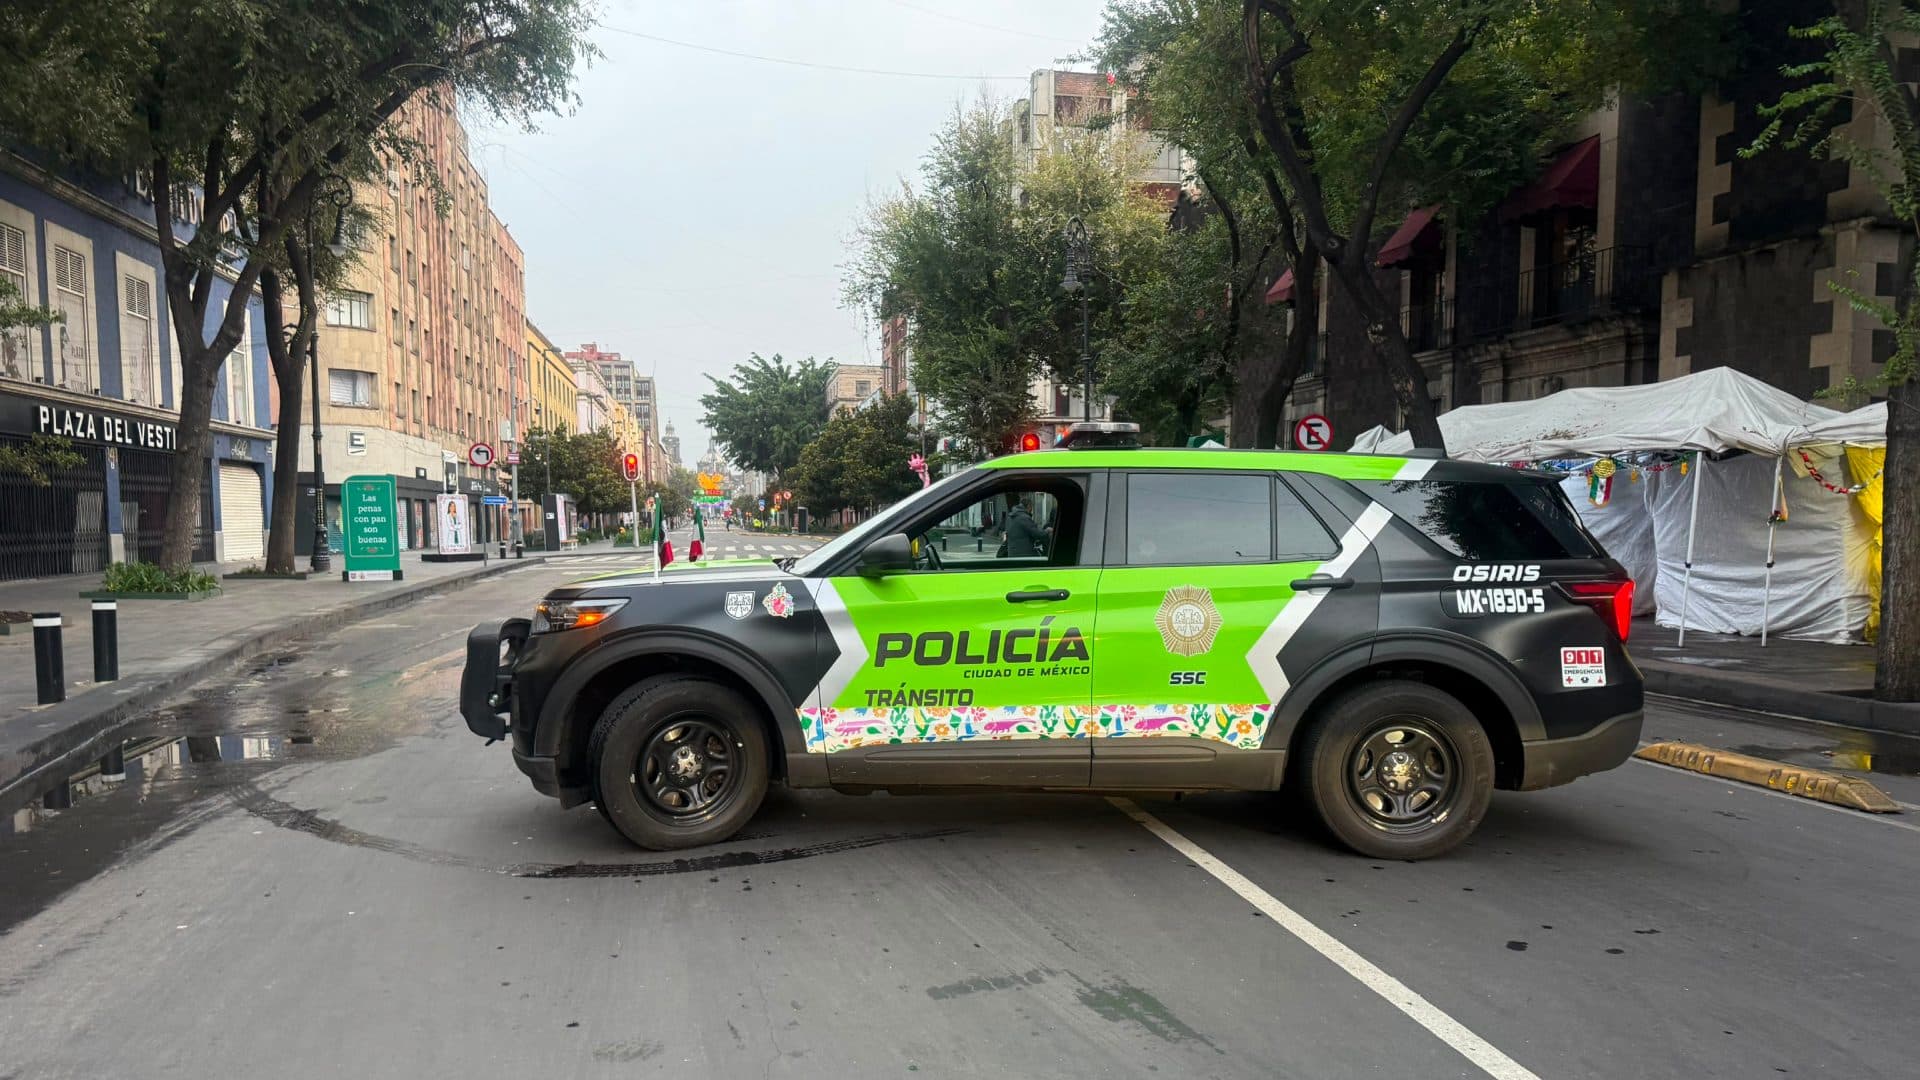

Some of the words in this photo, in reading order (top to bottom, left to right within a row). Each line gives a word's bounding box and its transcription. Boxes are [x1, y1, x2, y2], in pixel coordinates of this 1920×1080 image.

[39, 405, 97, 440] PLAZA
[103, 416, 133, 444] DEL
[362, 494, 377, 502] Las
[357, 505, 382, 514] penas
[353, 515, 369, 523] con
[371, 515, 387, 525] pan
[363, 526, 378, 534] son
[358, 536, 387, 544] buenas
[1453, 564, 1541, 582] OSIRIS
[874, 615, 1090, 668] POLICÍA
[1566, 651, 1600, 663] 911
[963, 668, 1012, 679] CIUDAD
[1017, 667, 1035, 677] DE
[1040, 664, 1090, 677] MÉXICO
[1169, 671, 1207, 685] SSC
[864, 682, 975, 707] TRÁNSITO
